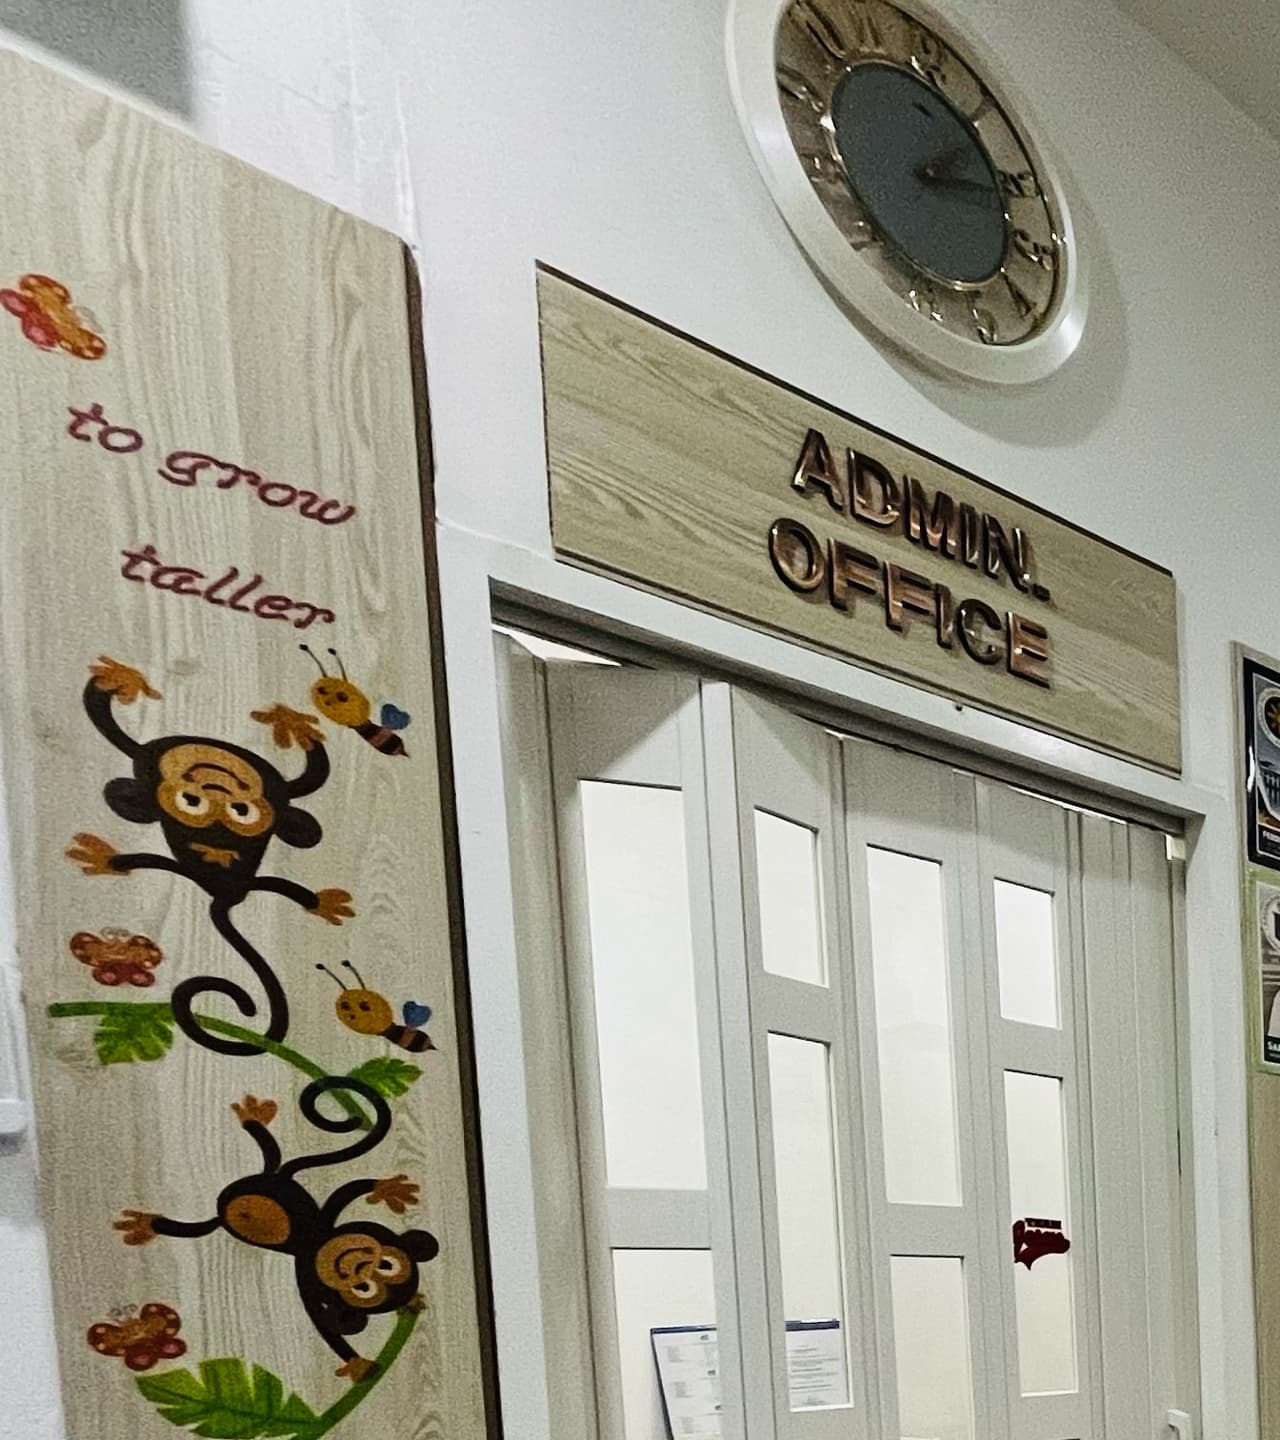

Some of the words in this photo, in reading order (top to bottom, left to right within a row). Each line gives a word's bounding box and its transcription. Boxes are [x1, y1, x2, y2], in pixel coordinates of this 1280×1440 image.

[68, 403, 142, 453] to
[157, 452, 355, 525] grow
[791, 427, 1051, 602] ADMIN.
[120, 545, 334, 628] taller
[767, 517, 1050, 689] OFFICE
